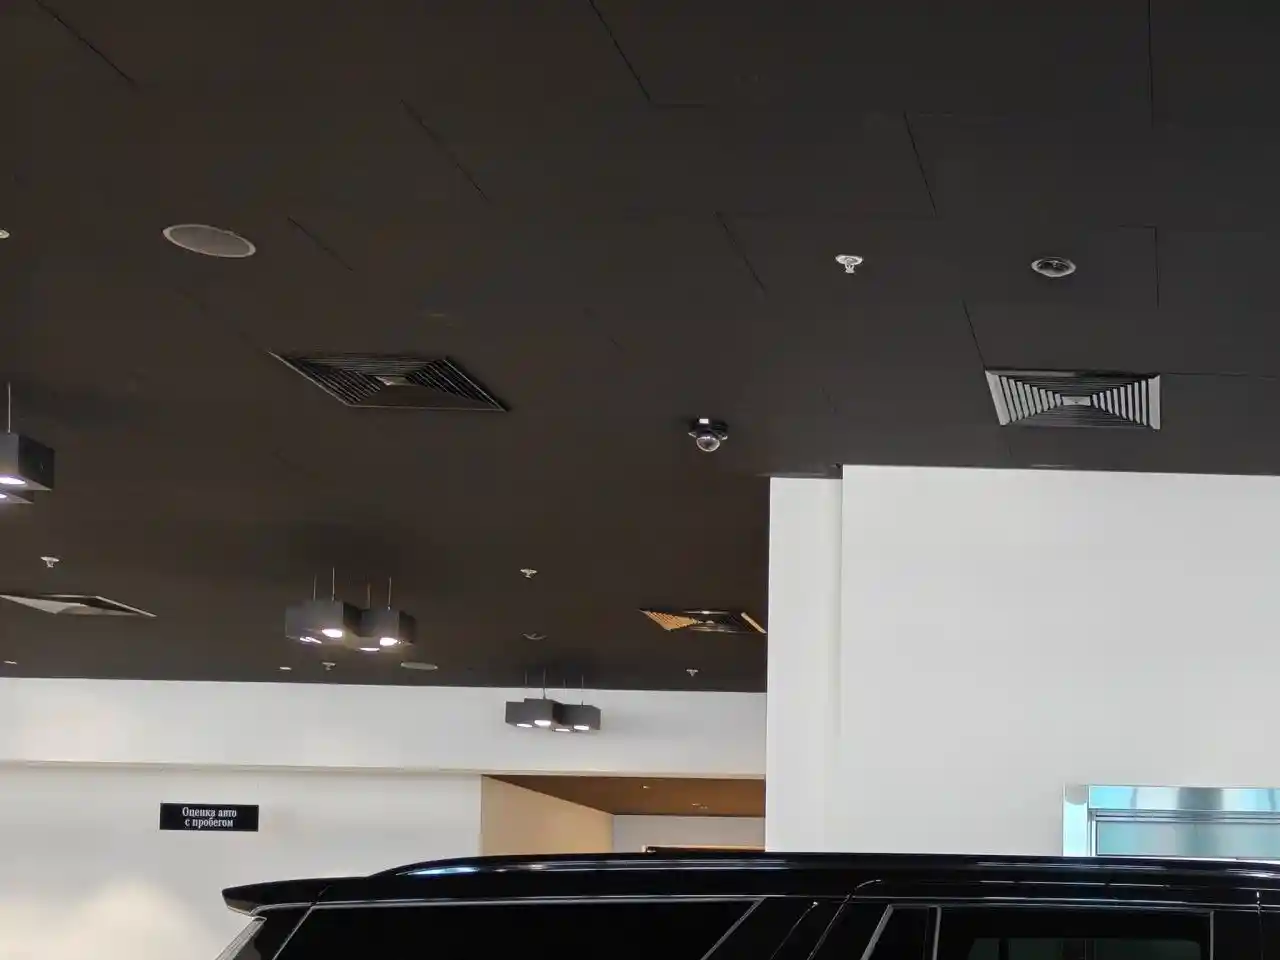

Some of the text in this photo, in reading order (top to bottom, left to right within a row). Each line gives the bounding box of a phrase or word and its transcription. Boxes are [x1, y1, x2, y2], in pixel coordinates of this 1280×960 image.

[182, 806, 237, 818] Оценка авто
[192, 816, 234, 829] пробегом
